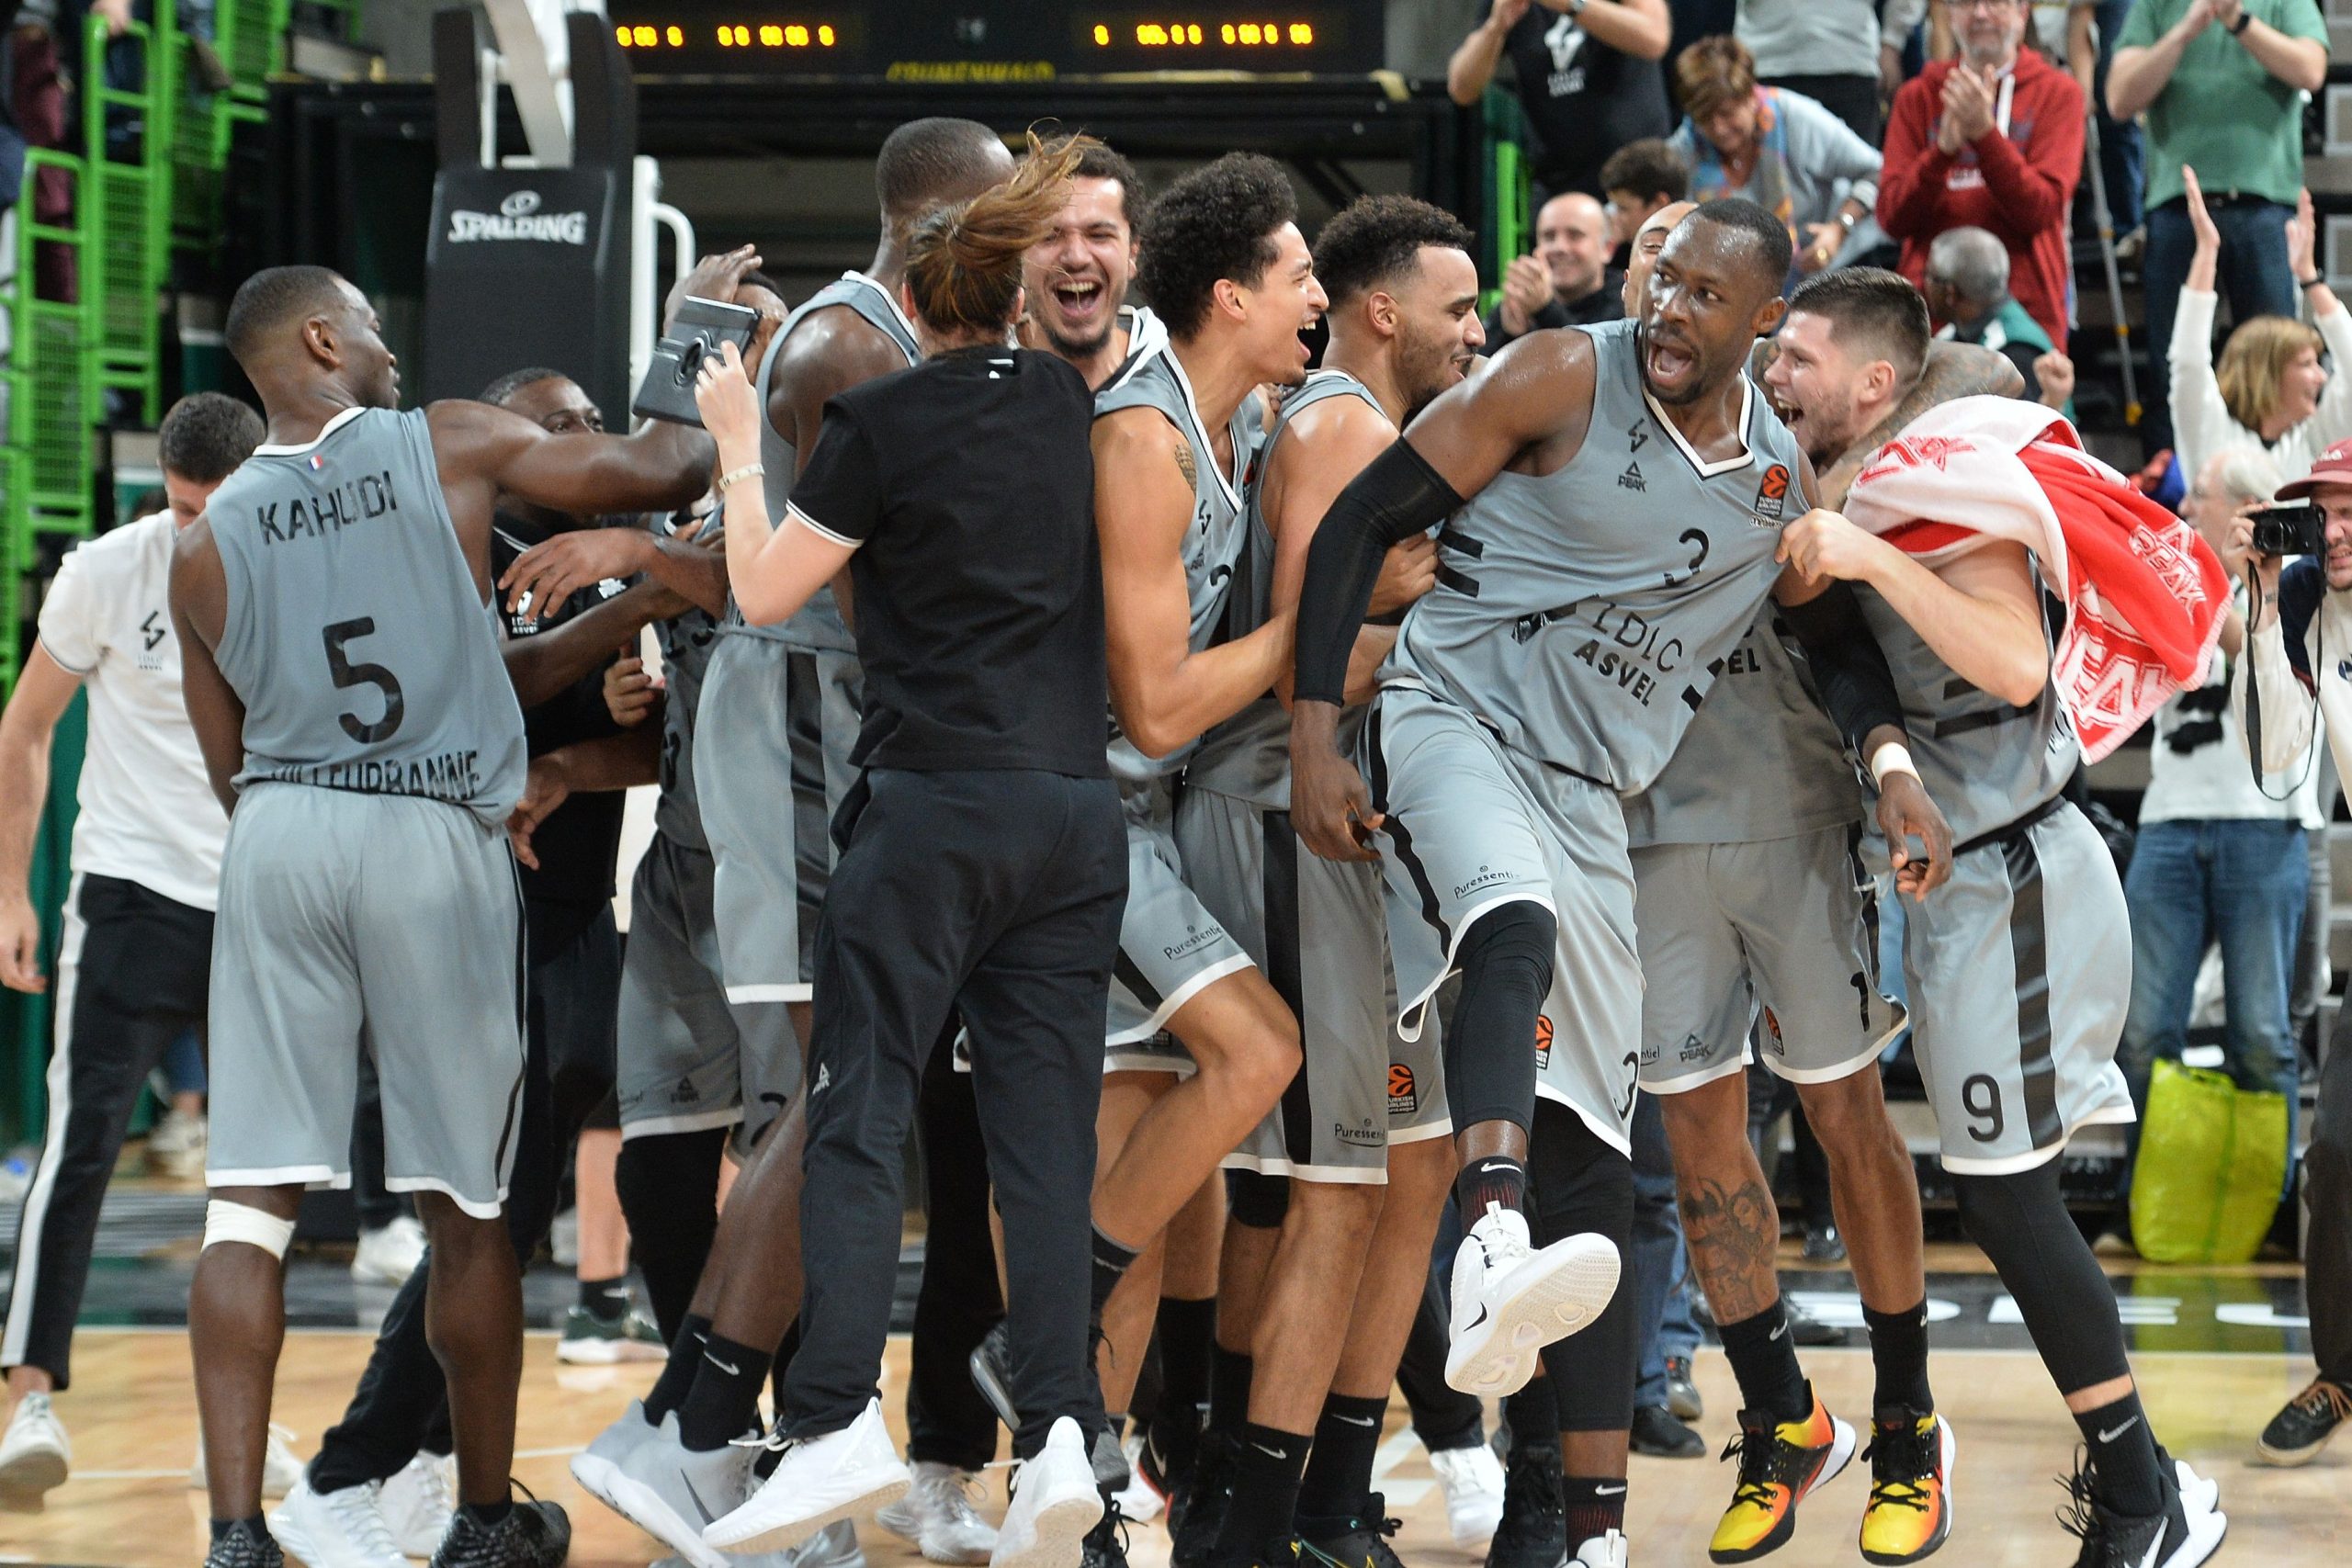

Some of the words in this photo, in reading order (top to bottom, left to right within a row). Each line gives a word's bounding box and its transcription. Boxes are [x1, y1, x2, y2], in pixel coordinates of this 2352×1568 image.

[447, 209, 587, 244] SPALDING
[1618, 475, 1646, 493] PEAK
[322, 616, 404, 744] 5
[1573, 639, 1656, 706] ASVEL
[1453, 871, 1515, 899] Puressenti
[1679, 1045, 1710, 1062] PEAK
[1962, 1074, 2004, 1143] 9
